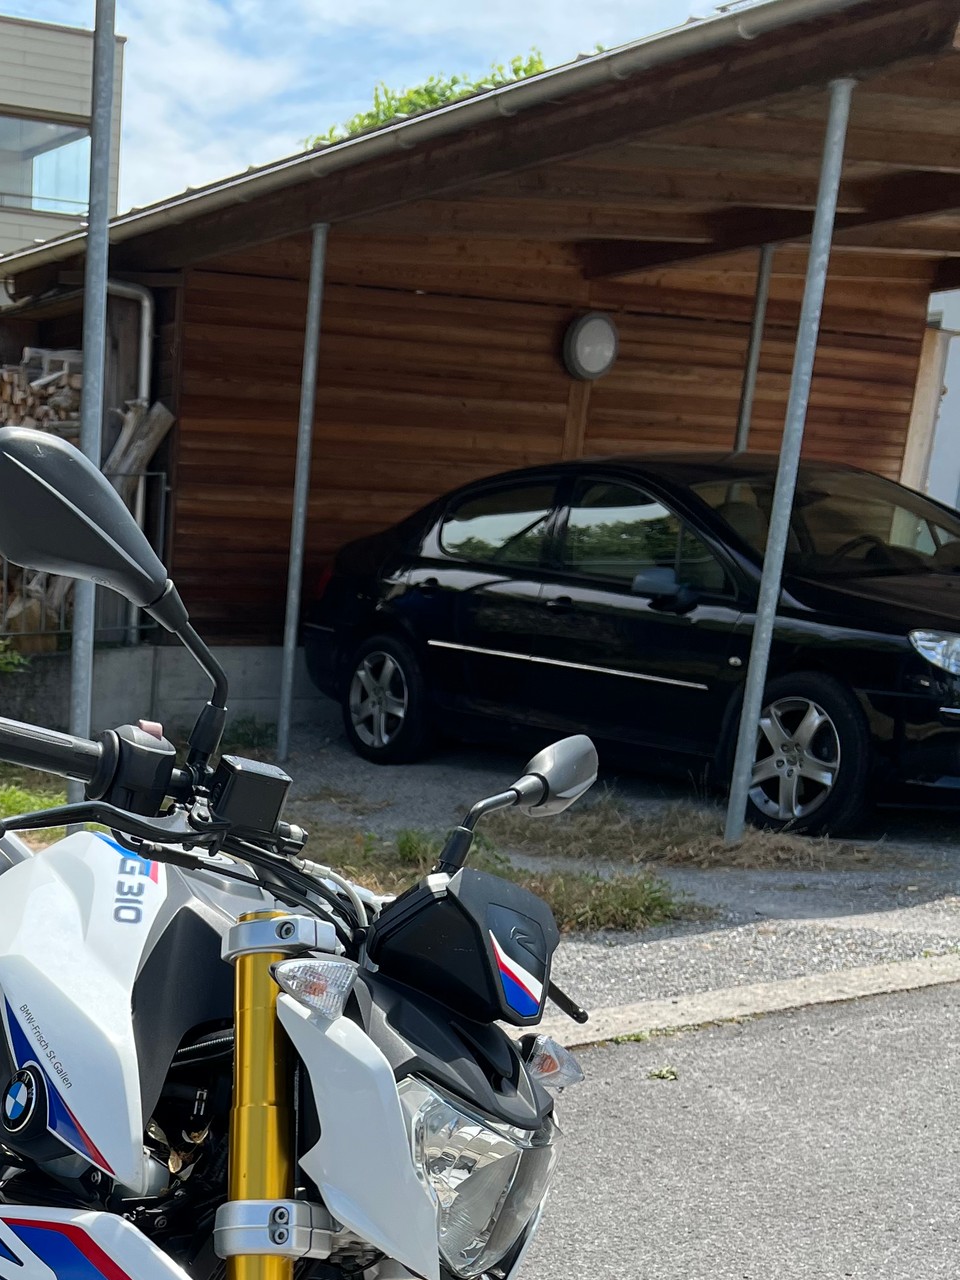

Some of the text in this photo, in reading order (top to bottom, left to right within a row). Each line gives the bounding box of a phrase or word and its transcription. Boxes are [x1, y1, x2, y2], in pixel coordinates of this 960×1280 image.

[113, 858, 145, 923] G 310
[20, 1004, 49, 1050] BMW-Frisch
